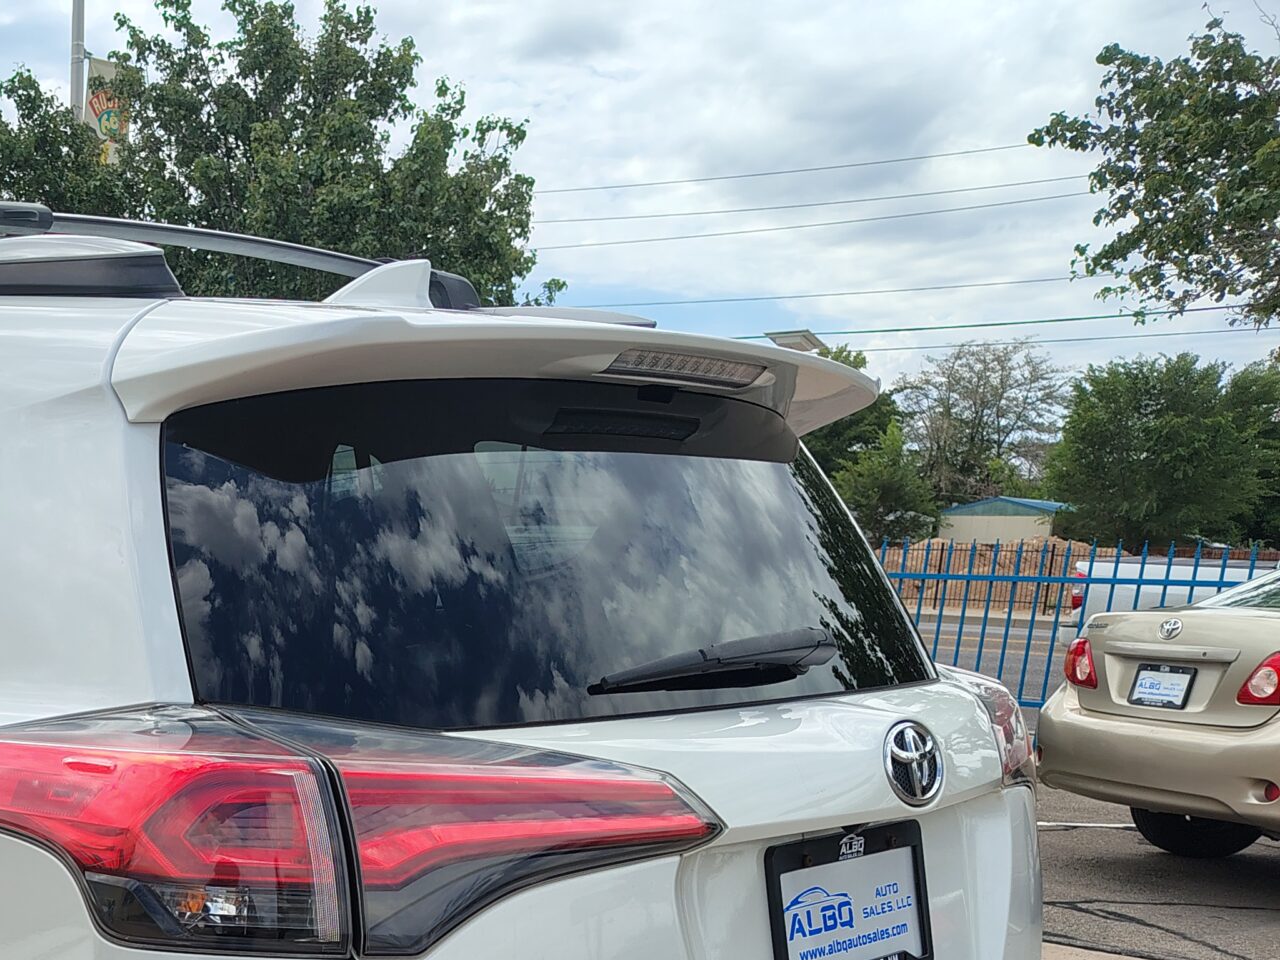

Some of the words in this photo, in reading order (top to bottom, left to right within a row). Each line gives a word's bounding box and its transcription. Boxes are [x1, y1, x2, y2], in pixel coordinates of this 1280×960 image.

[839, 839, 865, 856] ALBQ
[875, 882, 899, 898] AUTO
[896, 895, 913, 910] LLC
[788, 901, 854, 941] ALBQ
